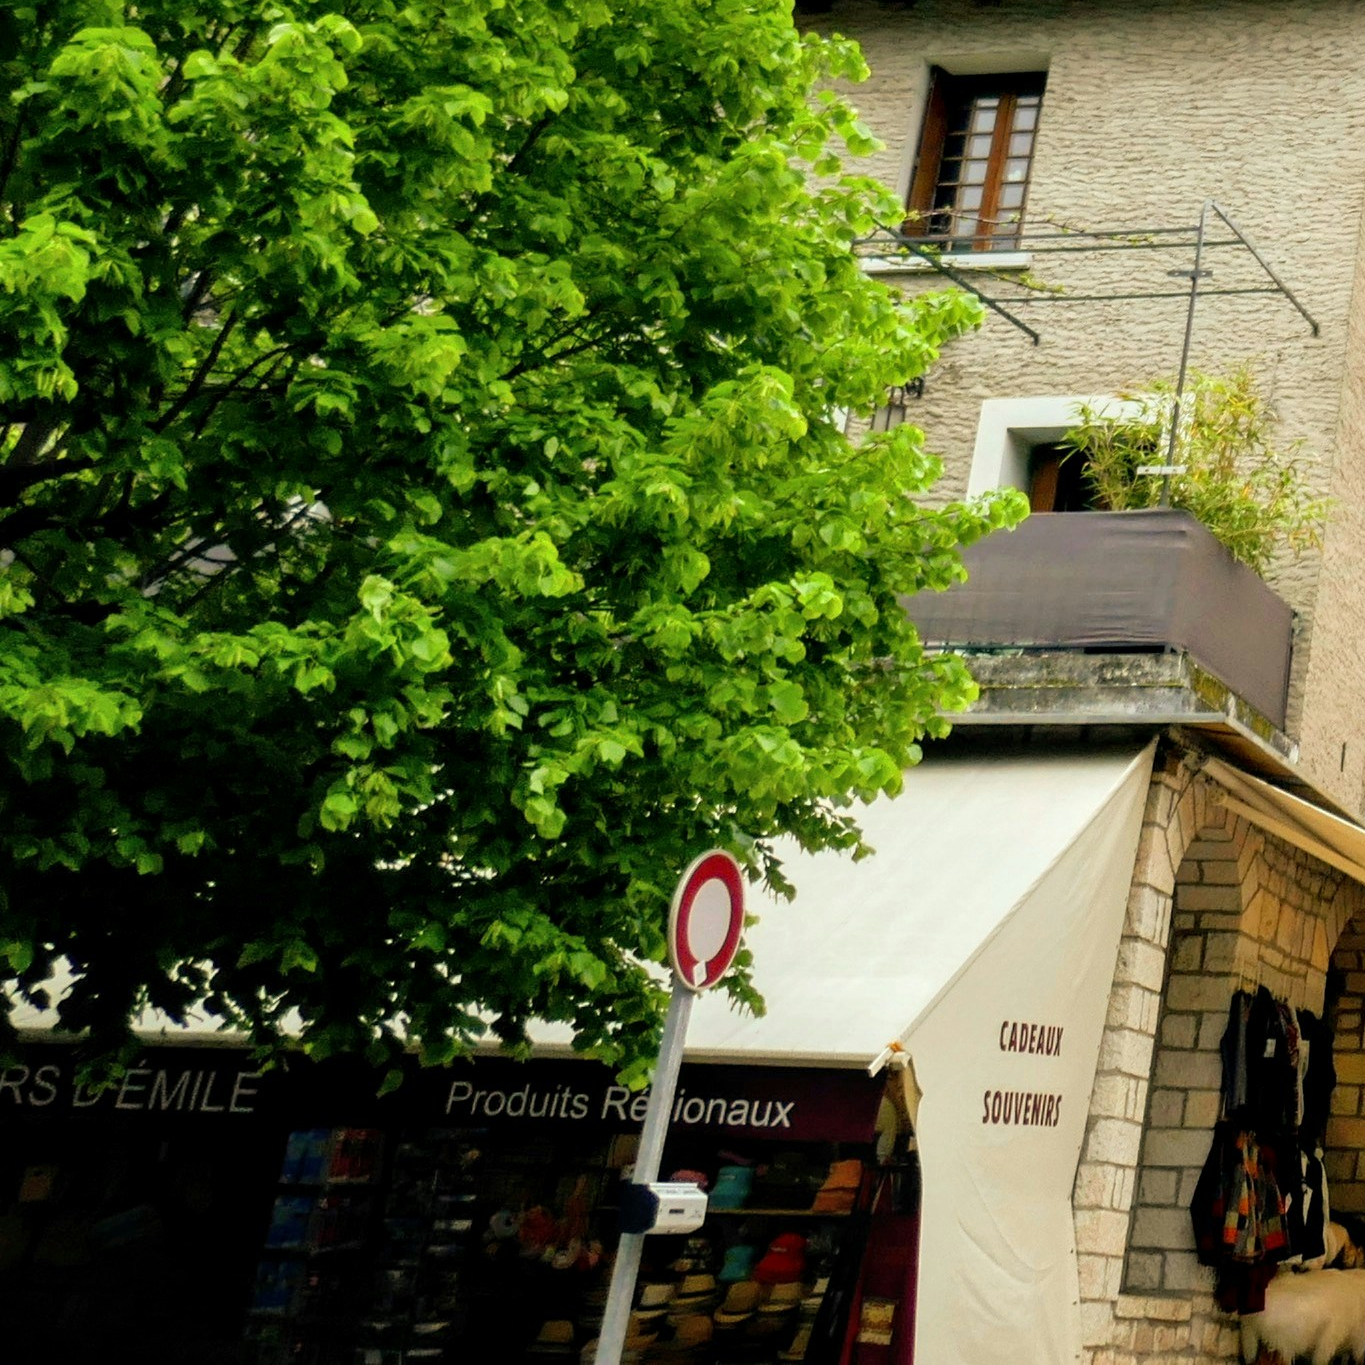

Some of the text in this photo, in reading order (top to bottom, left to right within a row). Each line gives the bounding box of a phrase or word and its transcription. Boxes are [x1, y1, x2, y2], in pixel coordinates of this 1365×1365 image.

[1000, 1020, 1064, 1057] CADEAUX
[0, 1059, 263, 1112] RS DÉMILE
[446, 1081, 796, 1128] Produits Réionaux
[982, 1090, 1063, 1128] SOUVENIRS
